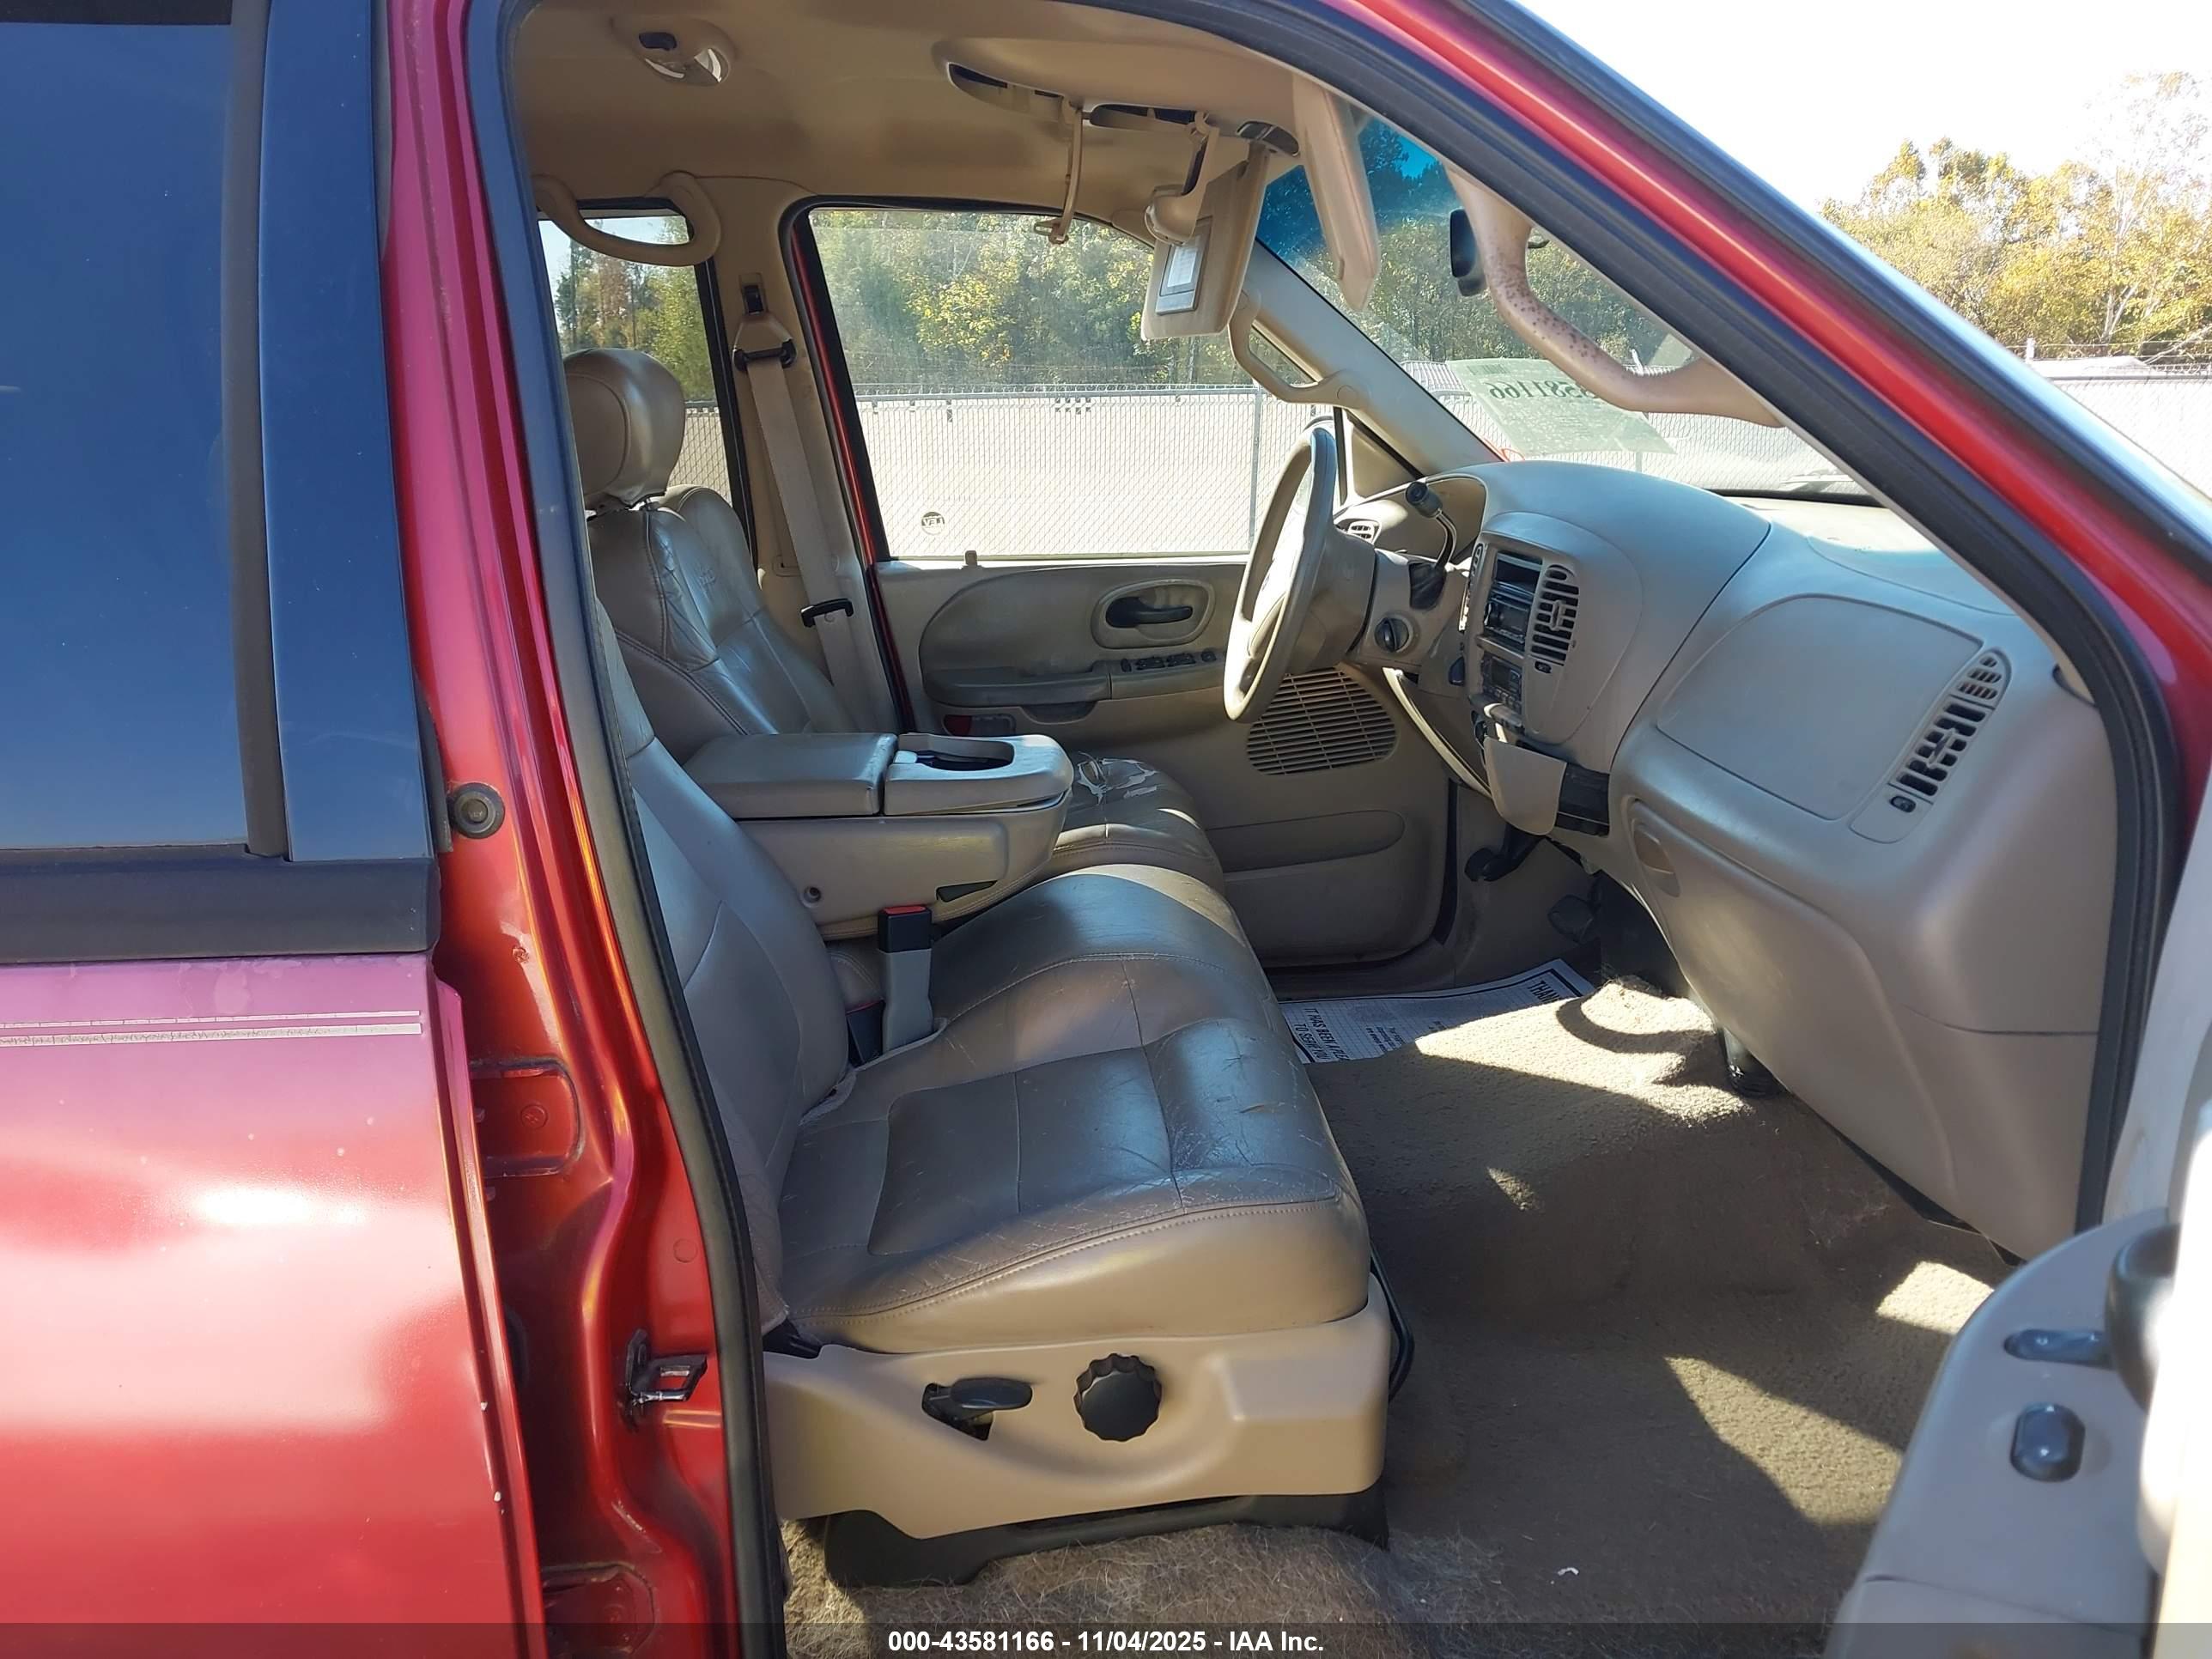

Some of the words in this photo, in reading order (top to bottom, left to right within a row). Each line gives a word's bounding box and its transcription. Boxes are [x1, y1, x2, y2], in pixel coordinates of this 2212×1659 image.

[1307, 1014, 1327, 1028] HAS
[1294, 1023, 1309, 1032] TO
[1311, 1048, 1331, 1060] YOU
[1316, 1029, 1338, 1044] BEEN
